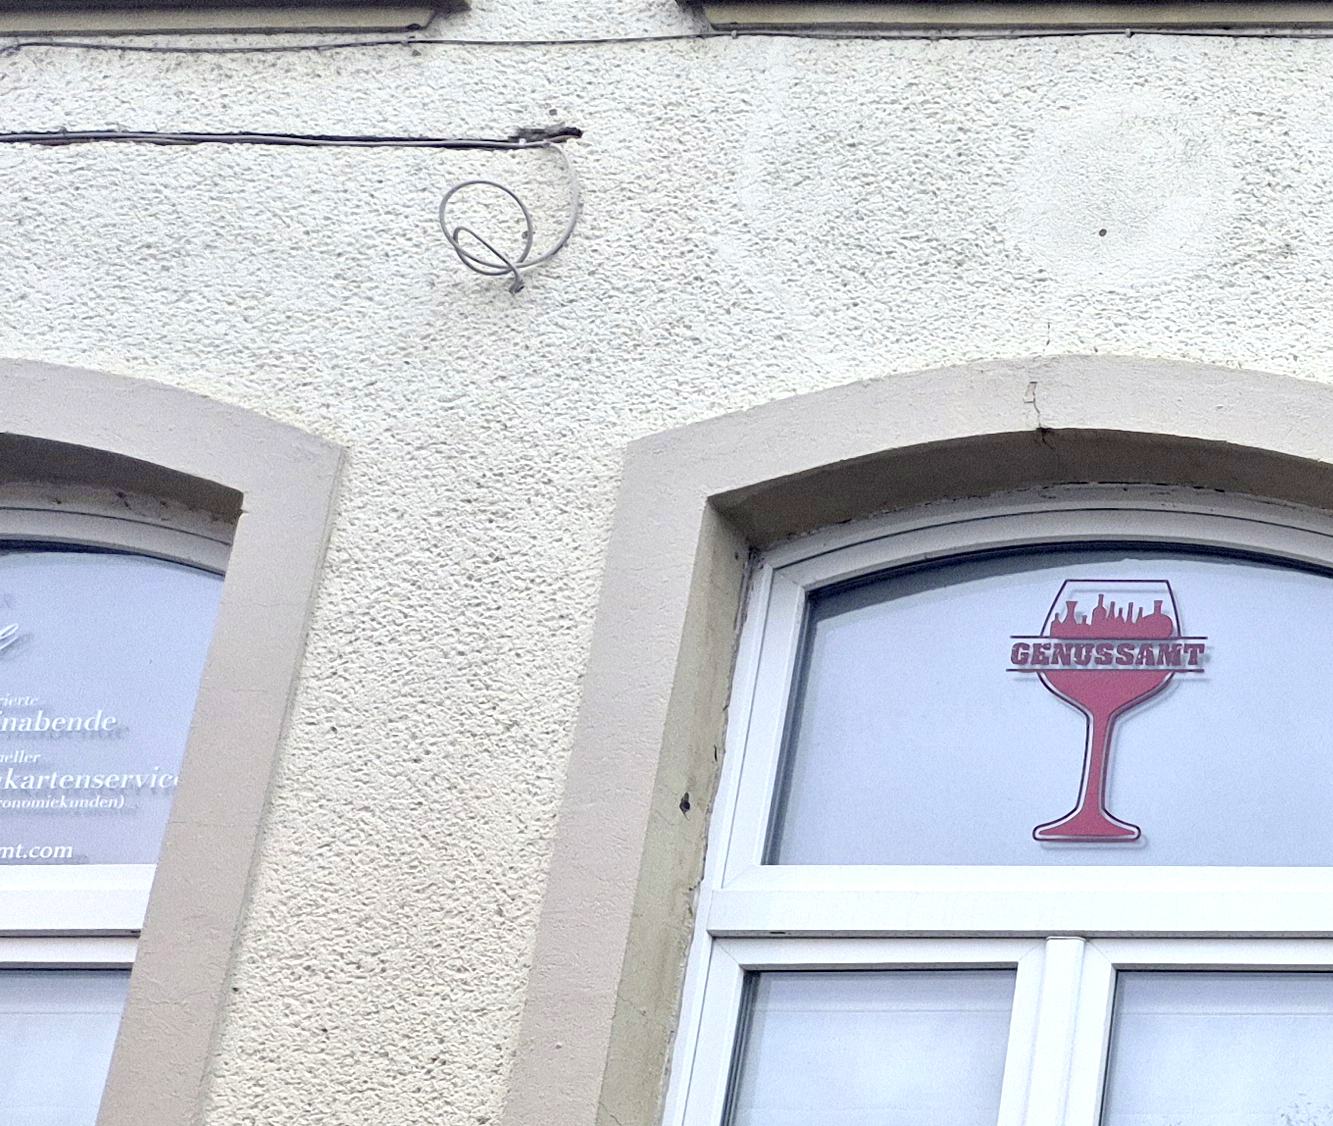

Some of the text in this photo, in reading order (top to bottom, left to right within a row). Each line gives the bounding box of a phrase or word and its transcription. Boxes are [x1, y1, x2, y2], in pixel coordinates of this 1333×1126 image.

[1010, 642, 1205, 666] GENUSSAMT
[0, 710, 117, 732] nabende
[0, 767, 179, 790] kartenservic
